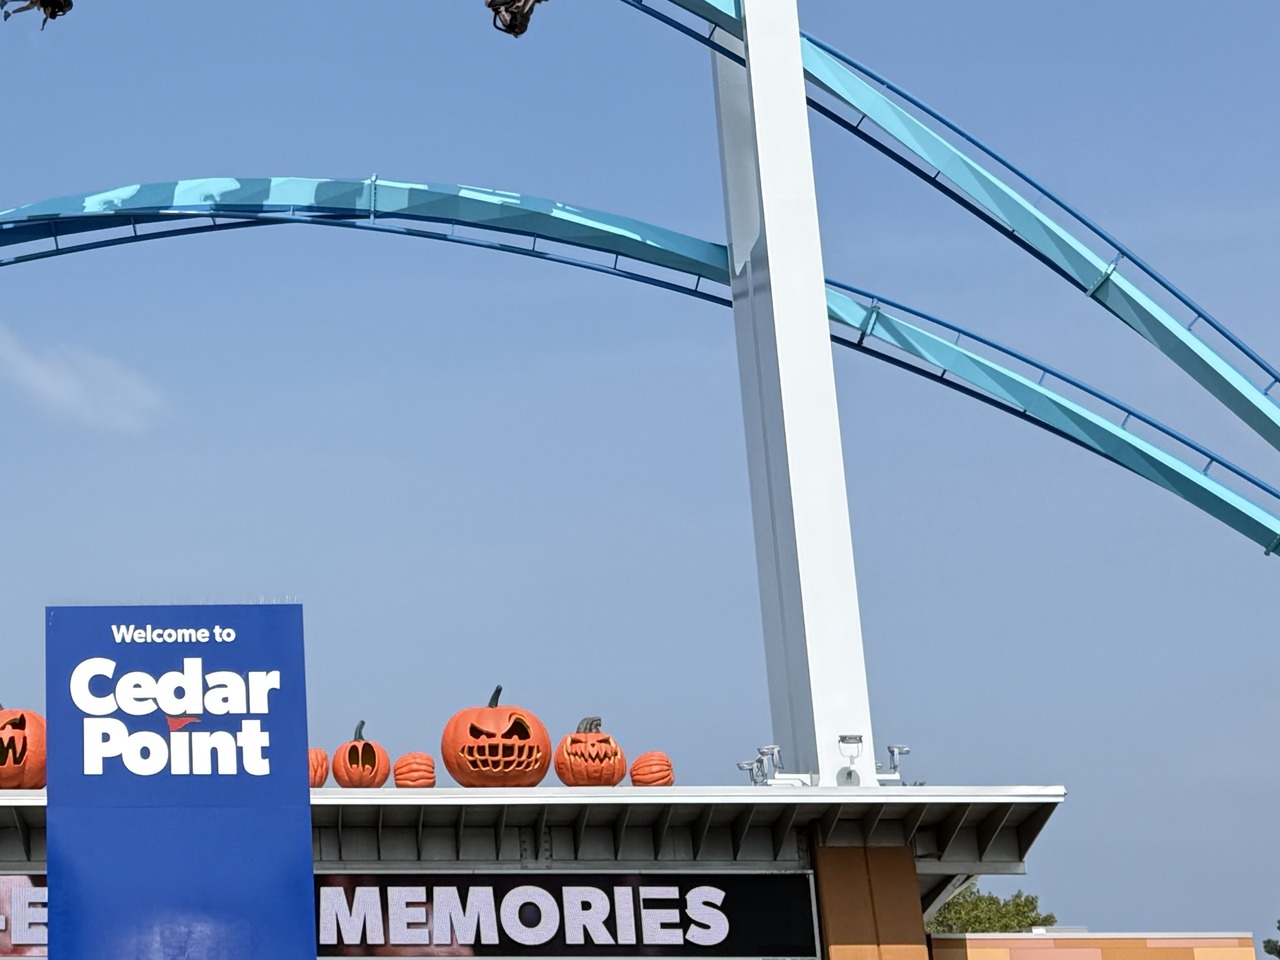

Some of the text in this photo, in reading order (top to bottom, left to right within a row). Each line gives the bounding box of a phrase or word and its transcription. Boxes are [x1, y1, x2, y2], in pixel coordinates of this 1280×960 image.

[110, 624, 237, 643] Welcome to
[69, 657, 281, 716] Cedar
[82, 717, 271, 776] Point
[319, 885, 730, 946] MEMORIES
